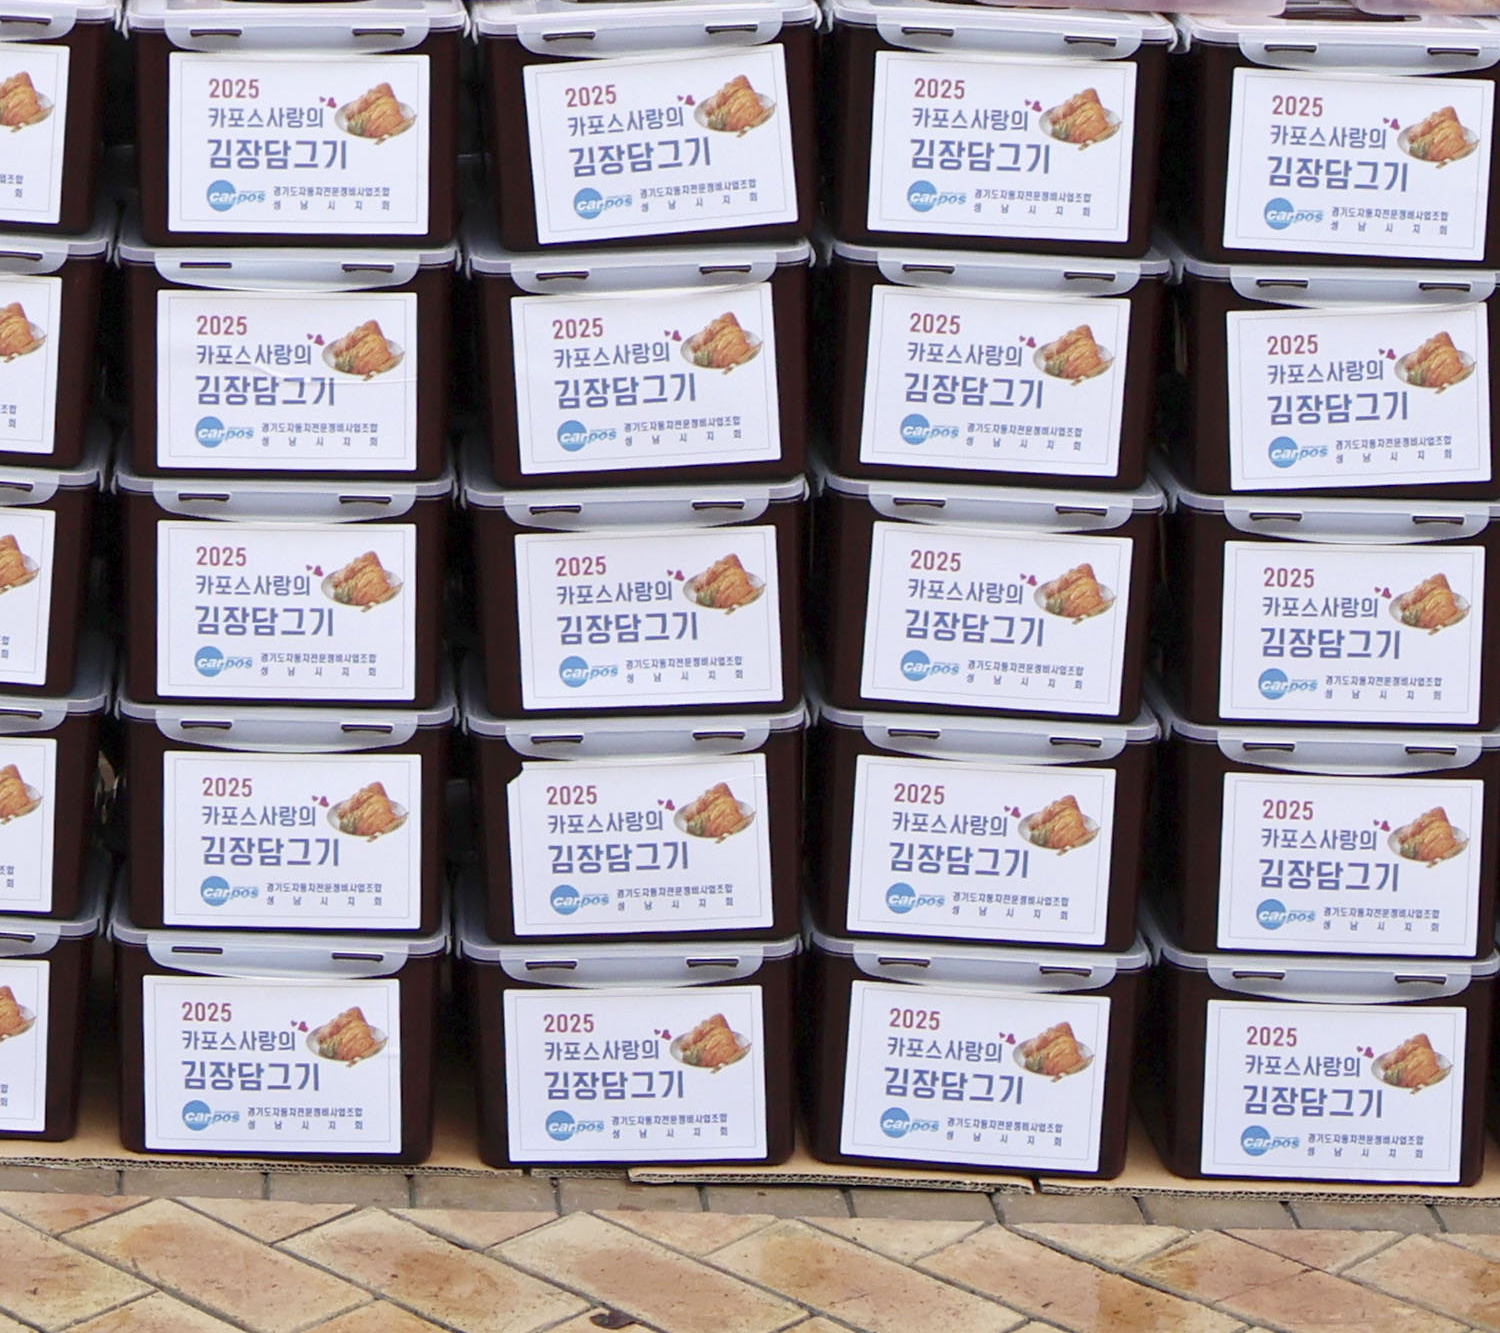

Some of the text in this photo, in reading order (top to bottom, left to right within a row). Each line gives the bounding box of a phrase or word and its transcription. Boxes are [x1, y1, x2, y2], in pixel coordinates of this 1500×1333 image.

[564, 83, 618, 109] 2025
[567, 106, 685, 138] 카포스사랑의
[569, 135, 712, 179] 김장담그기
[909, 312, 961, 335] 2025
[906, 341, 1024, 368] 카포스사랑의
[903, 372, 1045, 409] 김장담그기
[195, 546, 247, 567] 2025
[195, 574, 311, 597] 카포스사랑의
[1263, 567, 1315, 588] 2025
[1262, 596, 1379, 619] 카포스사랑의
[195, 605, 334, 637] 김장담그기
[1260, 627, 1401, 660] 김장담그기
[545, 785, 598, 807] 2025
[547, 810, 664, 835] 카포스사랑의
[548, 840, 690, 875] 김장담그기
[1246, 1026, 1298, 1047] 2025
[1244, 1054, 1361, 1078] 카포스사랑의
[1242, 1085, 1384, 1119] 김장담그기
